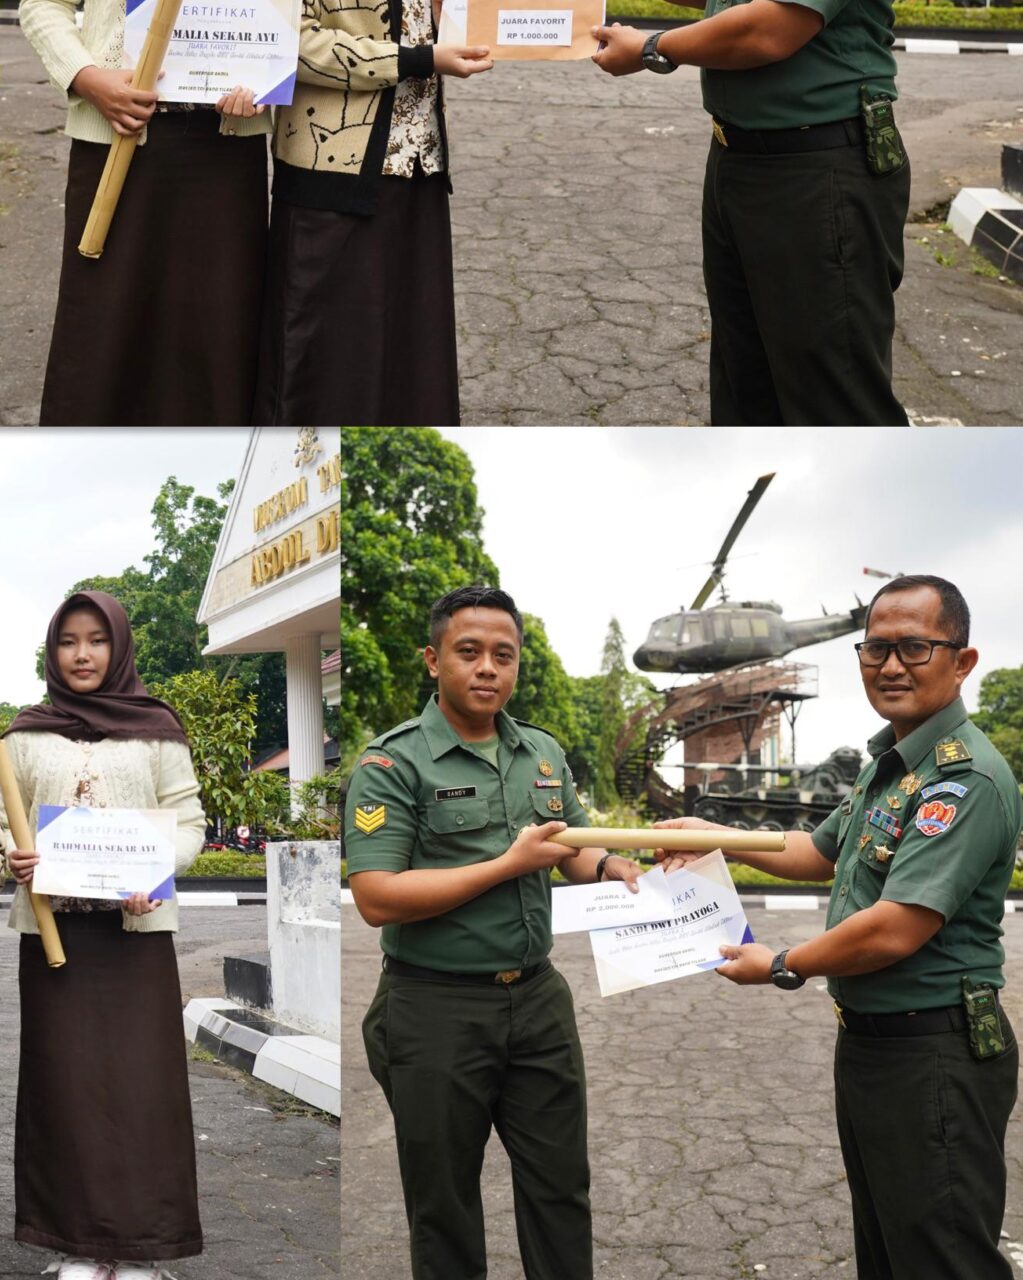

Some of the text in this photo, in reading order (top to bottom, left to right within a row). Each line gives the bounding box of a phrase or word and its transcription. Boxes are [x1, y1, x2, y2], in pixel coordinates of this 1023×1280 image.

[183, 6, 257, 18] ERTIFIKAT
[173, 29, 279, 42] MALIA SEKAR AYU
[251, 530, 310, 586] ABDUL
[53, 842, 102, 851] RAHMALIA
[616, 924, 649, 938] SANDI
[650, 920, 672, 932] DWI
[674, 901, 719, 925] PRAYOGA
